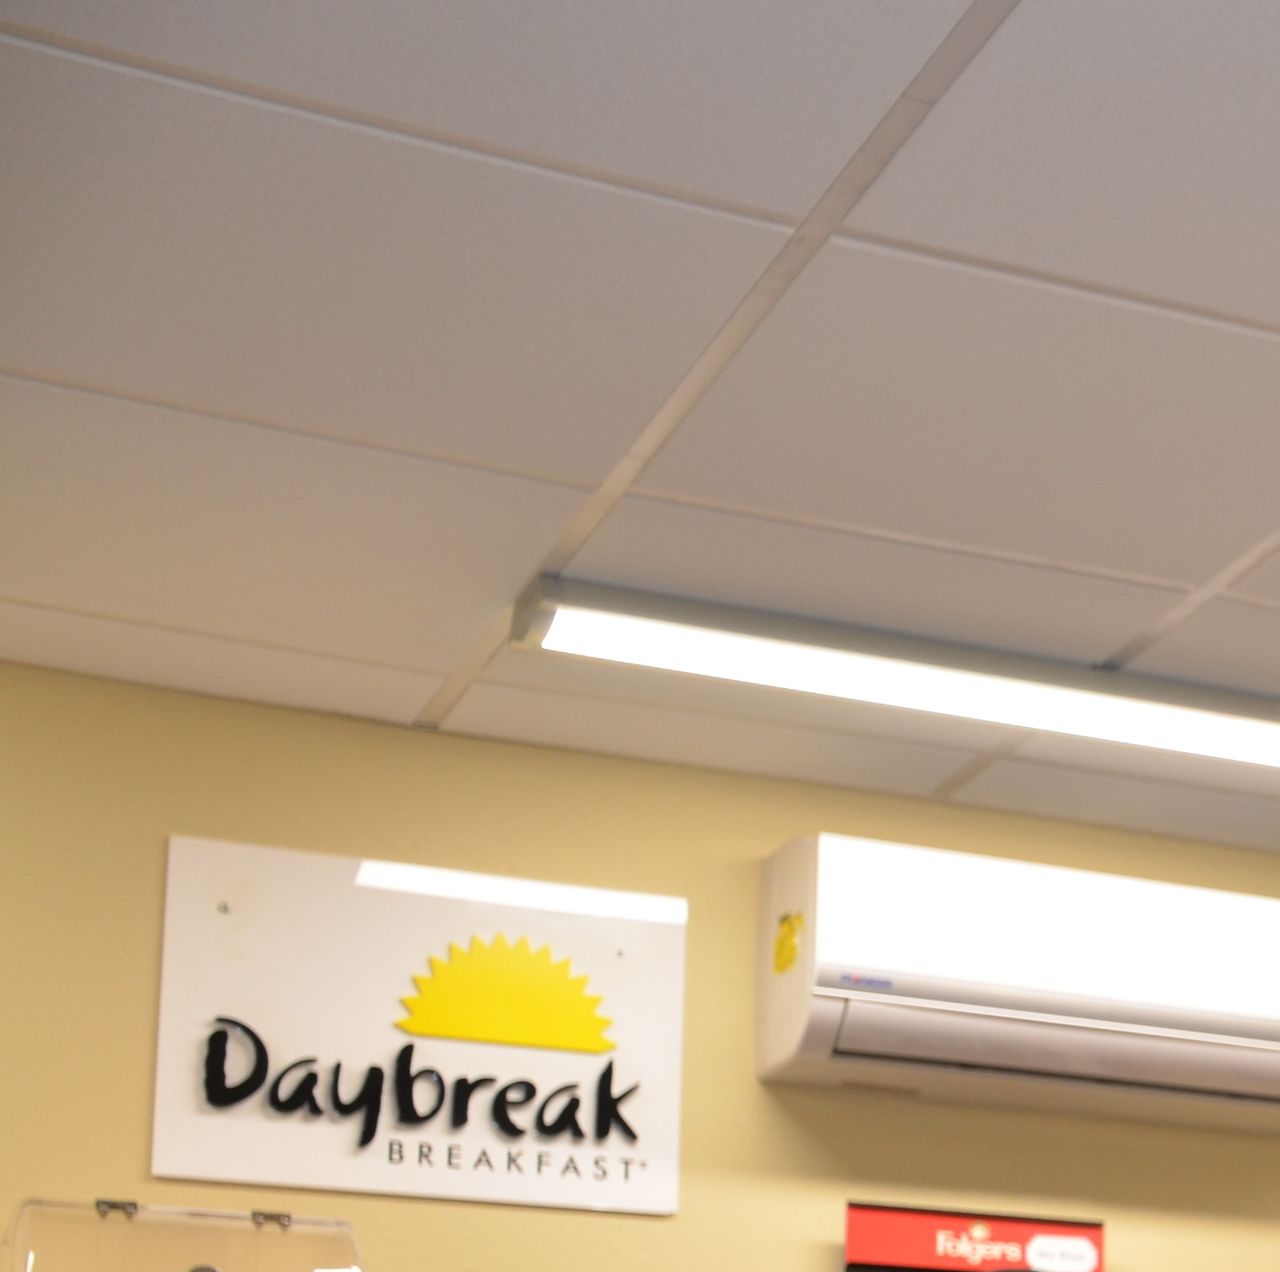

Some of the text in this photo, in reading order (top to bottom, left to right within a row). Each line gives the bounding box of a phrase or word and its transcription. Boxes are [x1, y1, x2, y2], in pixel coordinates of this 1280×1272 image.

[203, 1016, 640, 1148] Daybreak
[387, 1138, 636, 1182] BREAKFAST
[935, 1229, 1023, 1266] Folgers
